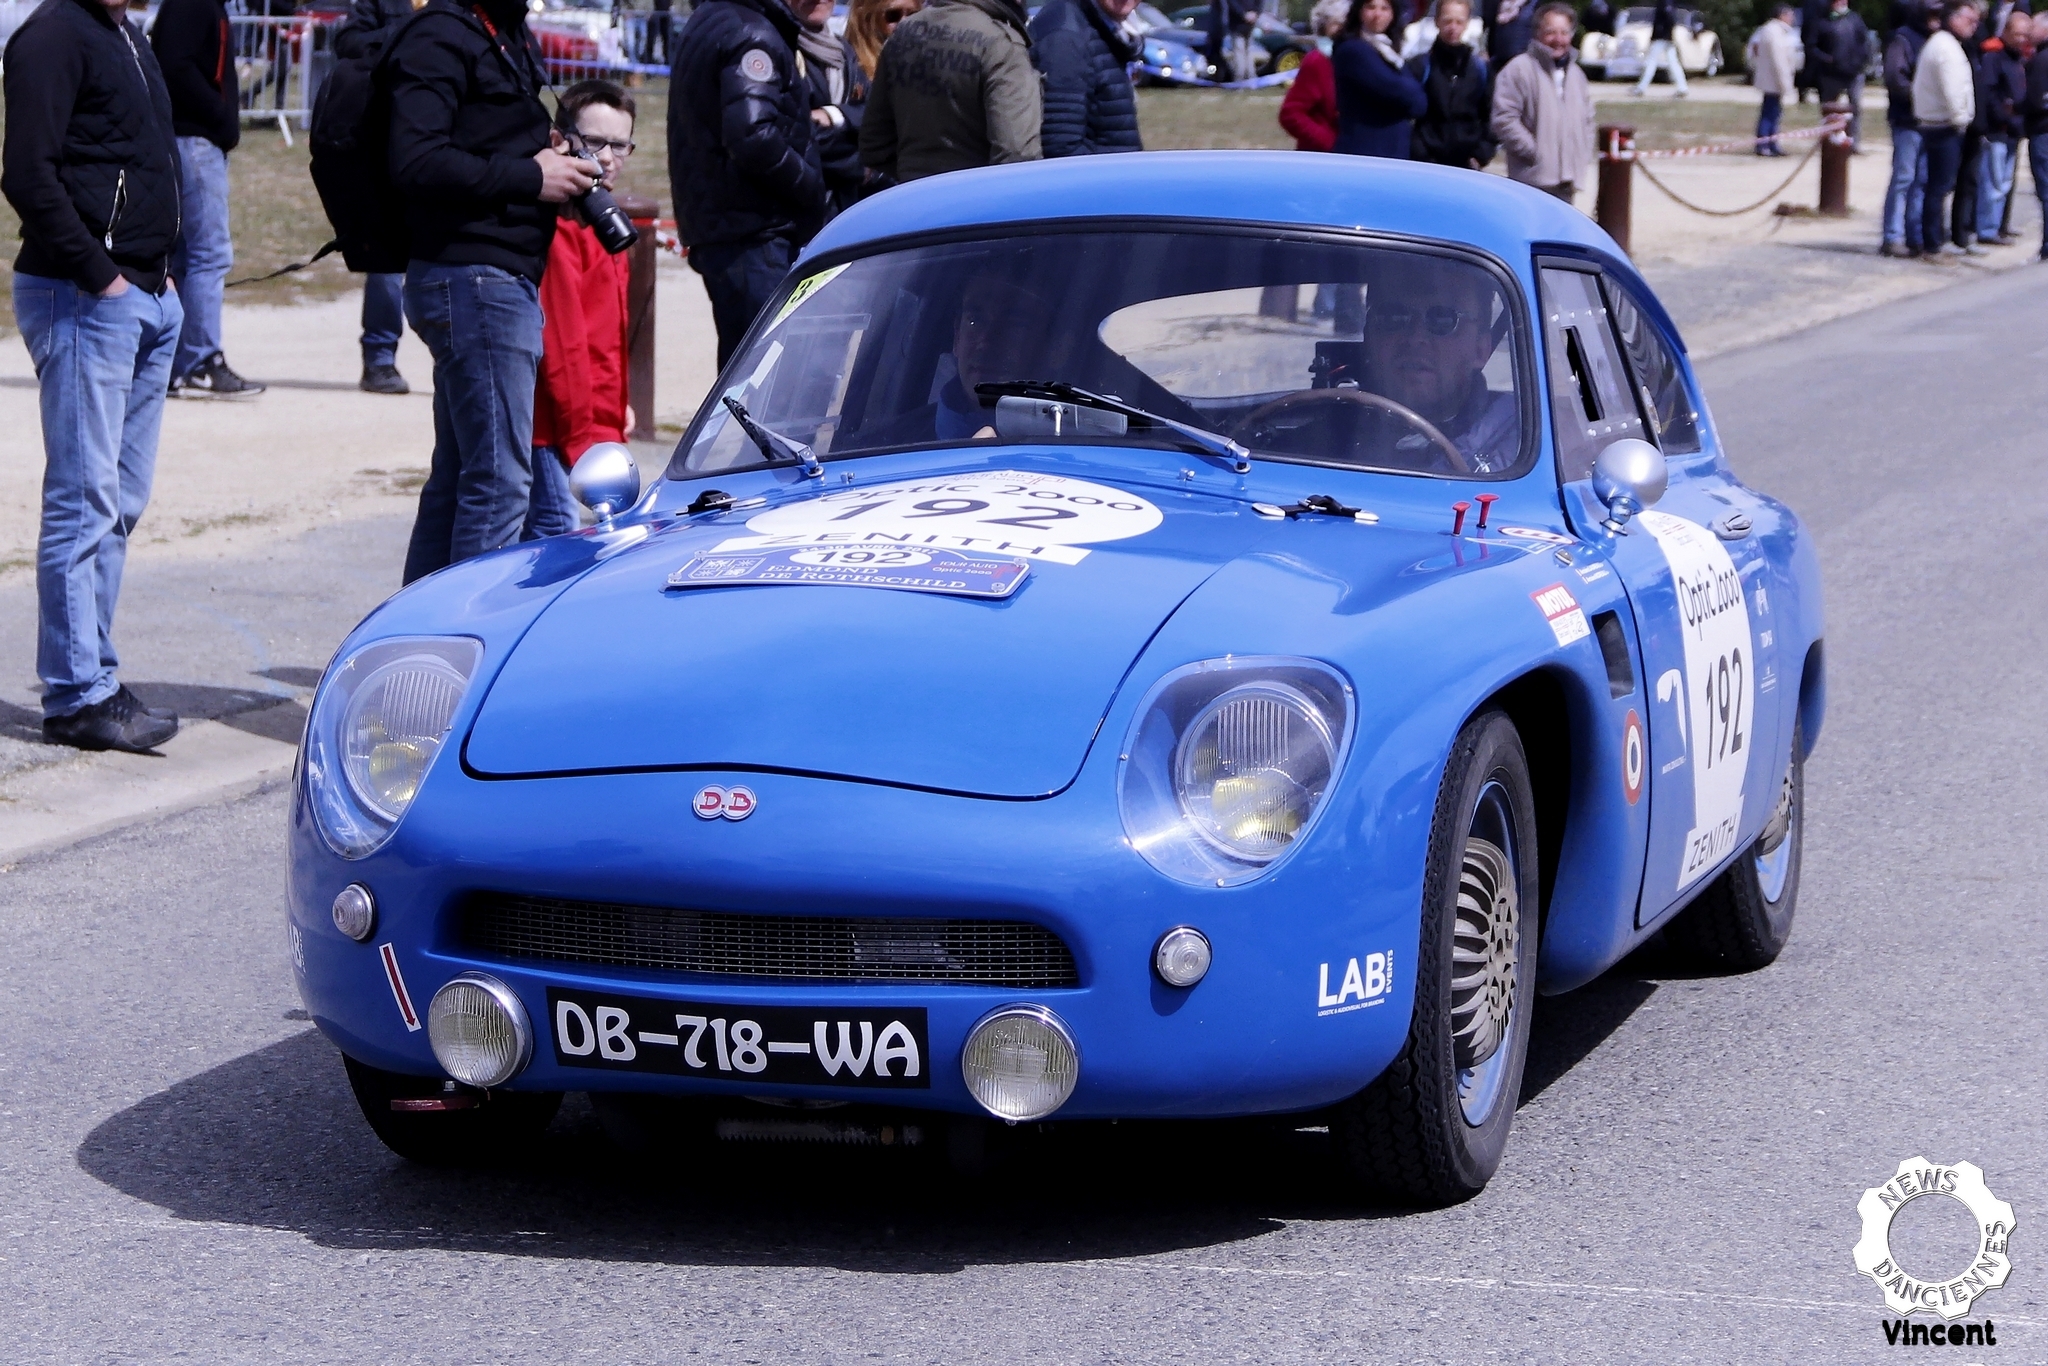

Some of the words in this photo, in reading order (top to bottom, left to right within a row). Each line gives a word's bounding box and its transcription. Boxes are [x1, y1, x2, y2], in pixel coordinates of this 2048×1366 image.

[820, 483, 979, 502] Optic
[991, 484, 1144, 511] 2000
[828, 498, 1080, 531] 192
[759, 532, 1046, 555] ZENITH
[816, 551, 912, 564] 192
[901, 545, 940, 555] 2017
[764, 565, 879, 574] EDMOND
[797, 573, 966, 588] ROTHSCHILD
[1535, 586, 1577, 617] MOTUL
[1678, 570, 1717, 641] Optic
[1709, 563, 1740, 612] 2000
[1706, 647, 1744, 770] 192
[1688, 812, 1737, 874] ZENITH
[1318, 952, 1386, 1008] LAB
[1386, 949, 1394, 994] EVENTS
[556, 1000, 920, 1078] DB-718-WA
